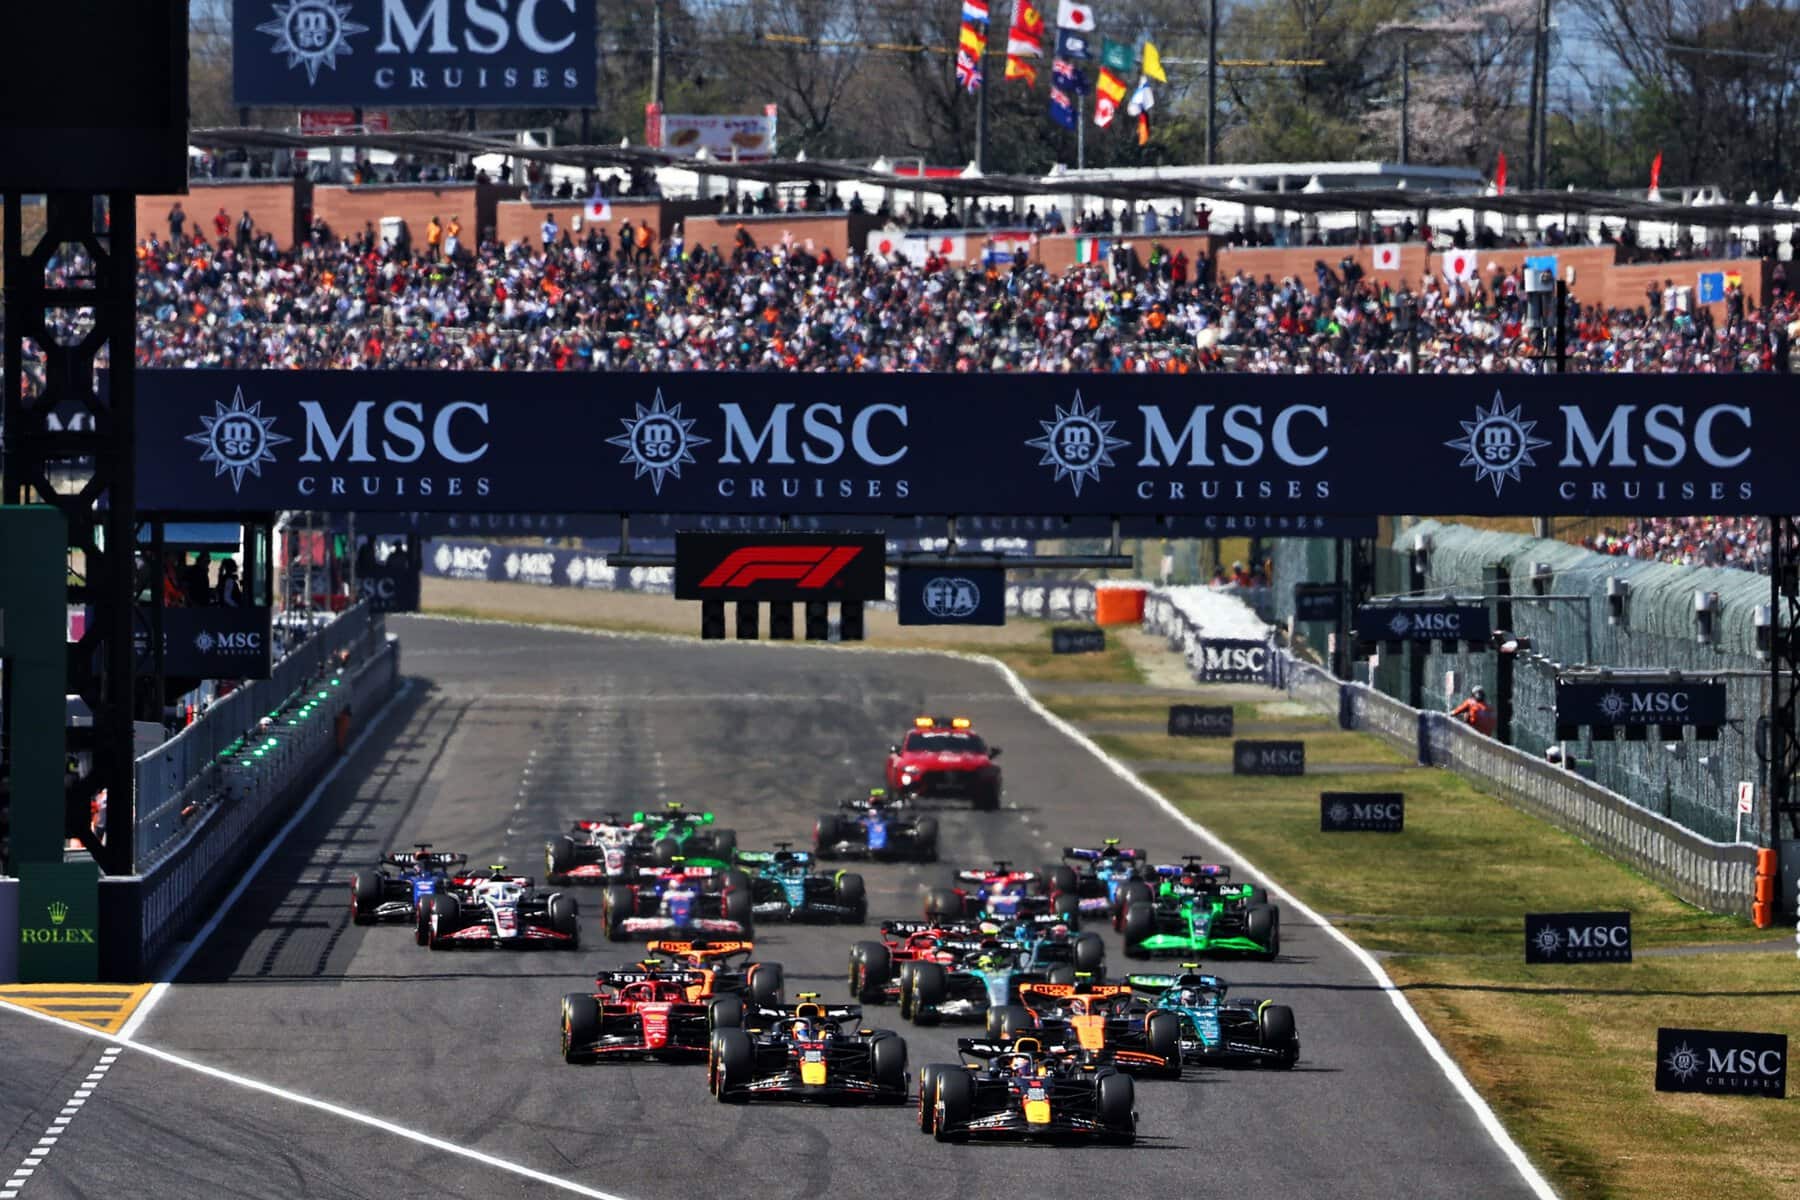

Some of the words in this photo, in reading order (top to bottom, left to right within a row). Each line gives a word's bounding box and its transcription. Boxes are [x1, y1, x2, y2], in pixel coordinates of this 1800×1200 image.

[376, 0, 576, 53] MSC
[374, 68, 577, 88] CRUISES
[299, 401, 489, 463] MSC
[718, 403, 908, 465] MSC
[1138, 404, 1329, 467] MSC
[1560, 404, 1752, 467] MSC
[299, 477, 490, 495] CRUISES
[718, 479, 909, 497] CRUISES
[1138, 481, 1330, 499] CRUISES
[1560, 482, 1752, 499] CRUISES
[1414, 613, 1460, 630] MSC
[218, 632, 260, 648] MSC
[1206, 647, 1264, 671] MSC
[1632, 693, 1689, 712] MSC
[1261, 749, 1302, 765] MSC
[1353, 803, 1400, 820] MSC
[22, 929, 95, 943] ROLEX
[1567, 926, 1628, 947] MSC
[1708, 1048, 1781, 1075] MSC
[1706, 1076, 1781, 1089] CRUISES
